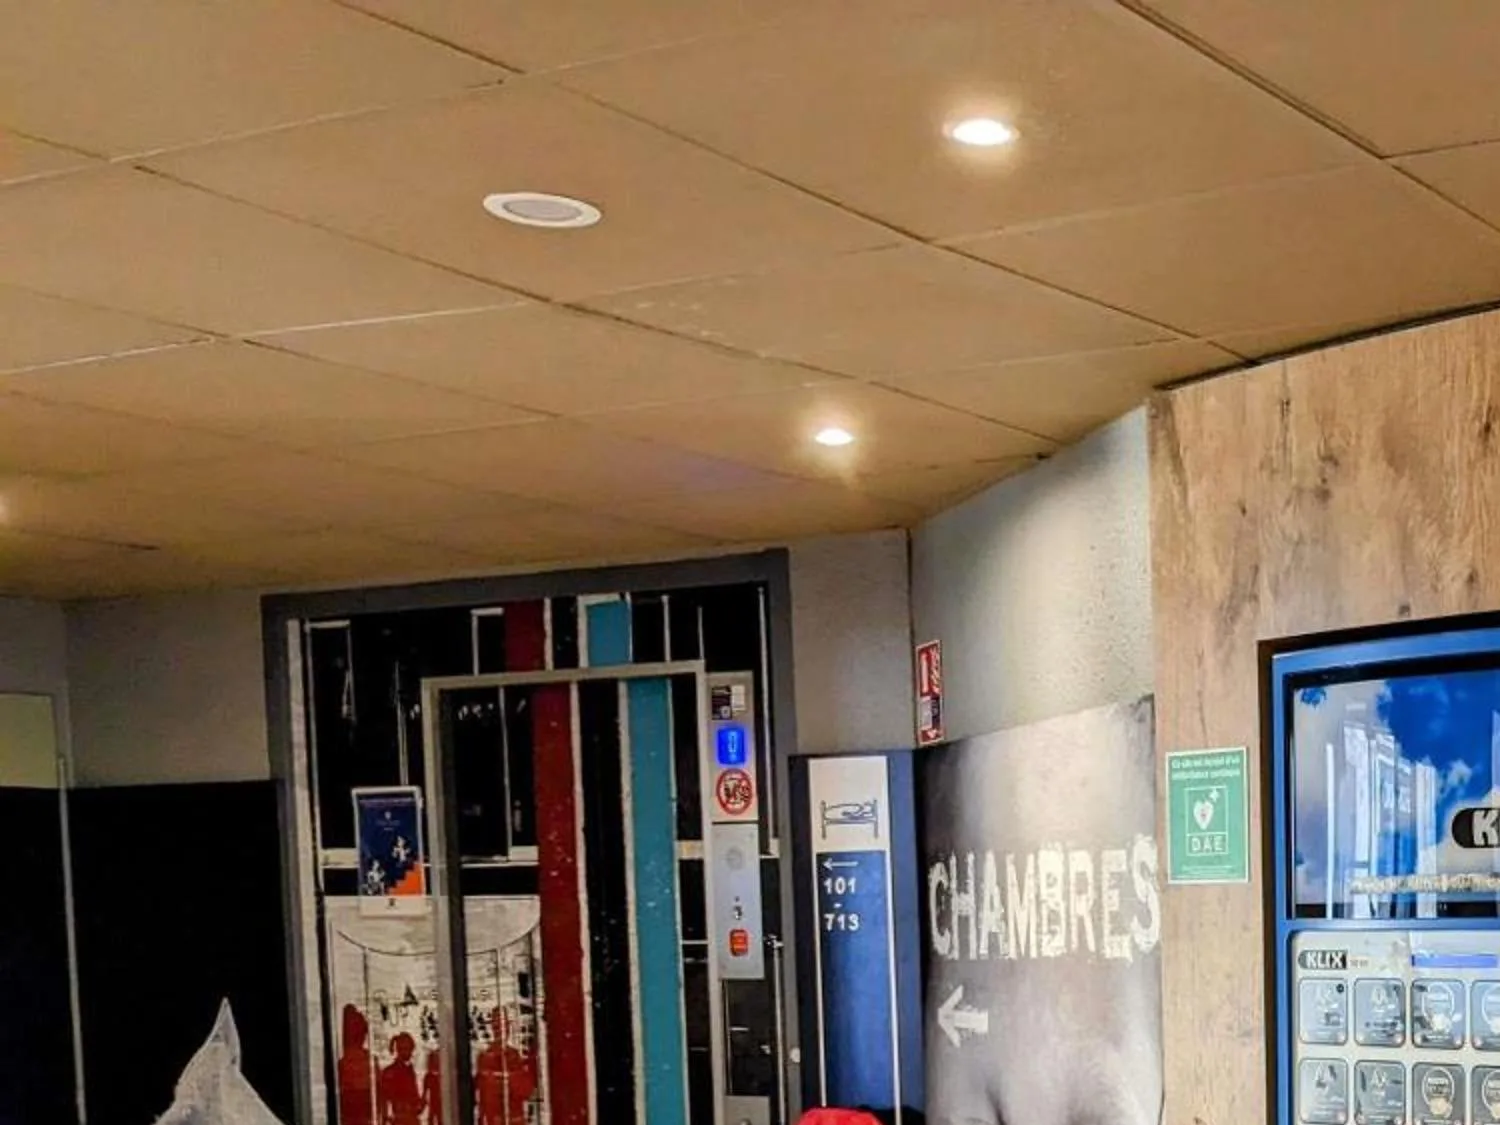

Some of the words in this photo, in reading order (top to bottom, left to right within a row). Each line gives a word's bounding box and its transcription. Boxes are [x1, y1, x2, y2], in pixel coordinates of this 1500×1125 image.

[1191, 836, 1224, 852] DAE
[824, 877, 856, 895] 101
[928, 834, 1160, 963] CHAMBRES
[1306, 951, 1344, 969] KLIX
